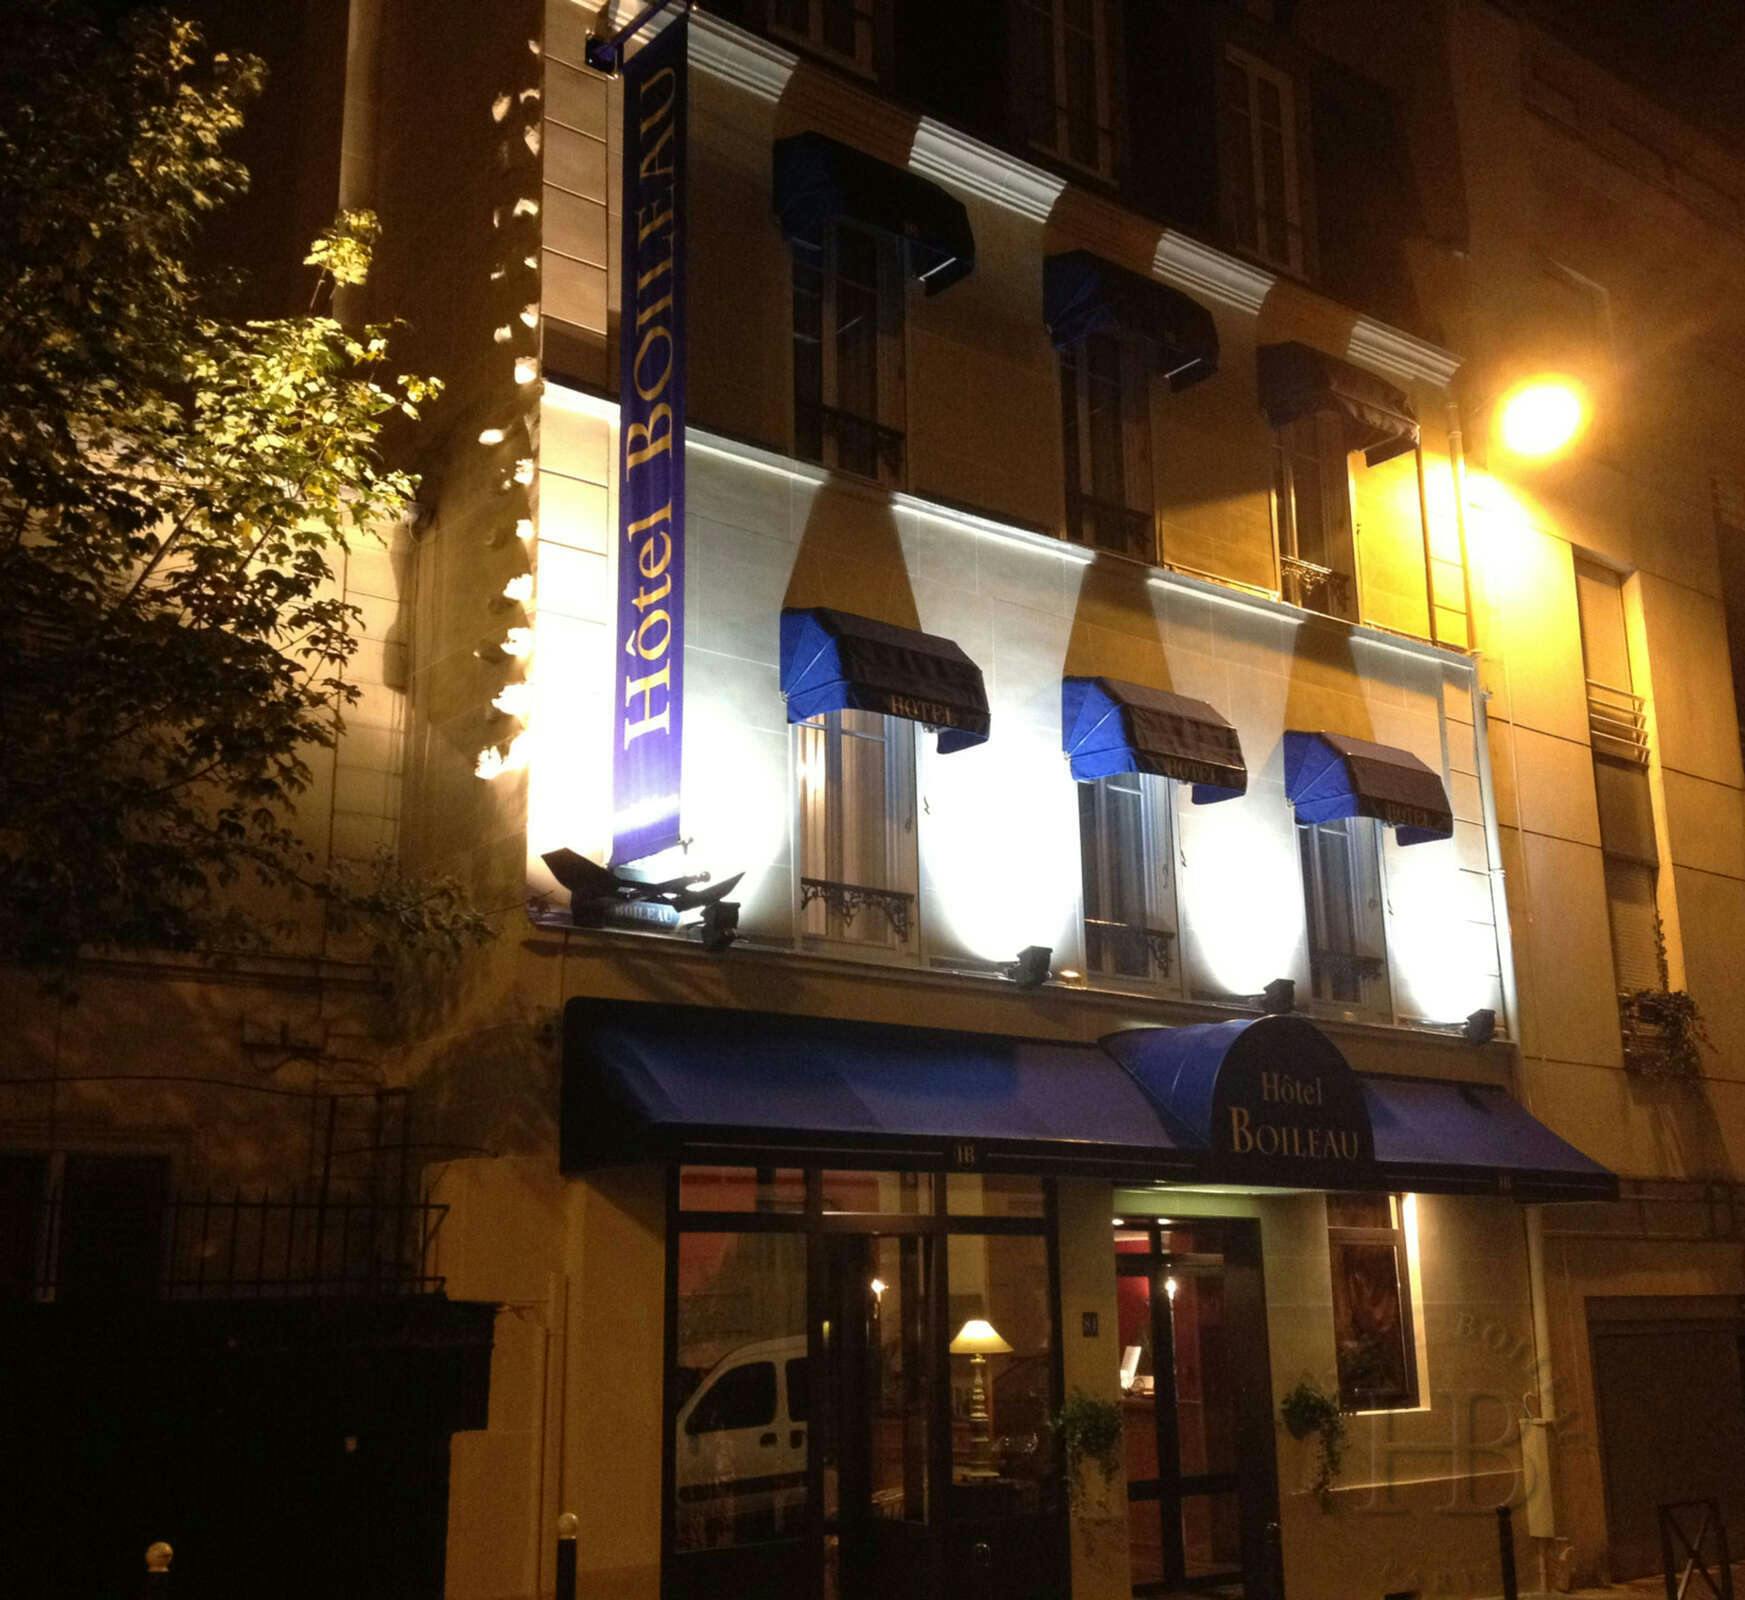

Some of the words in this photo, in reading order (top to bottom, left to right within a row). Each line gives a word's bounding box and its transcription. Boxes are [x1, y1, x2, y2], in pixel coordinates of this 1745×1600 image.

[626, 66, 676, 483] BOILEAU
[624, 497, 673, 751] Hôtel
[1228, 1105, 1360, 1161] BOILEAU
[1260, 1071, 1323, 1105] Hôtel
